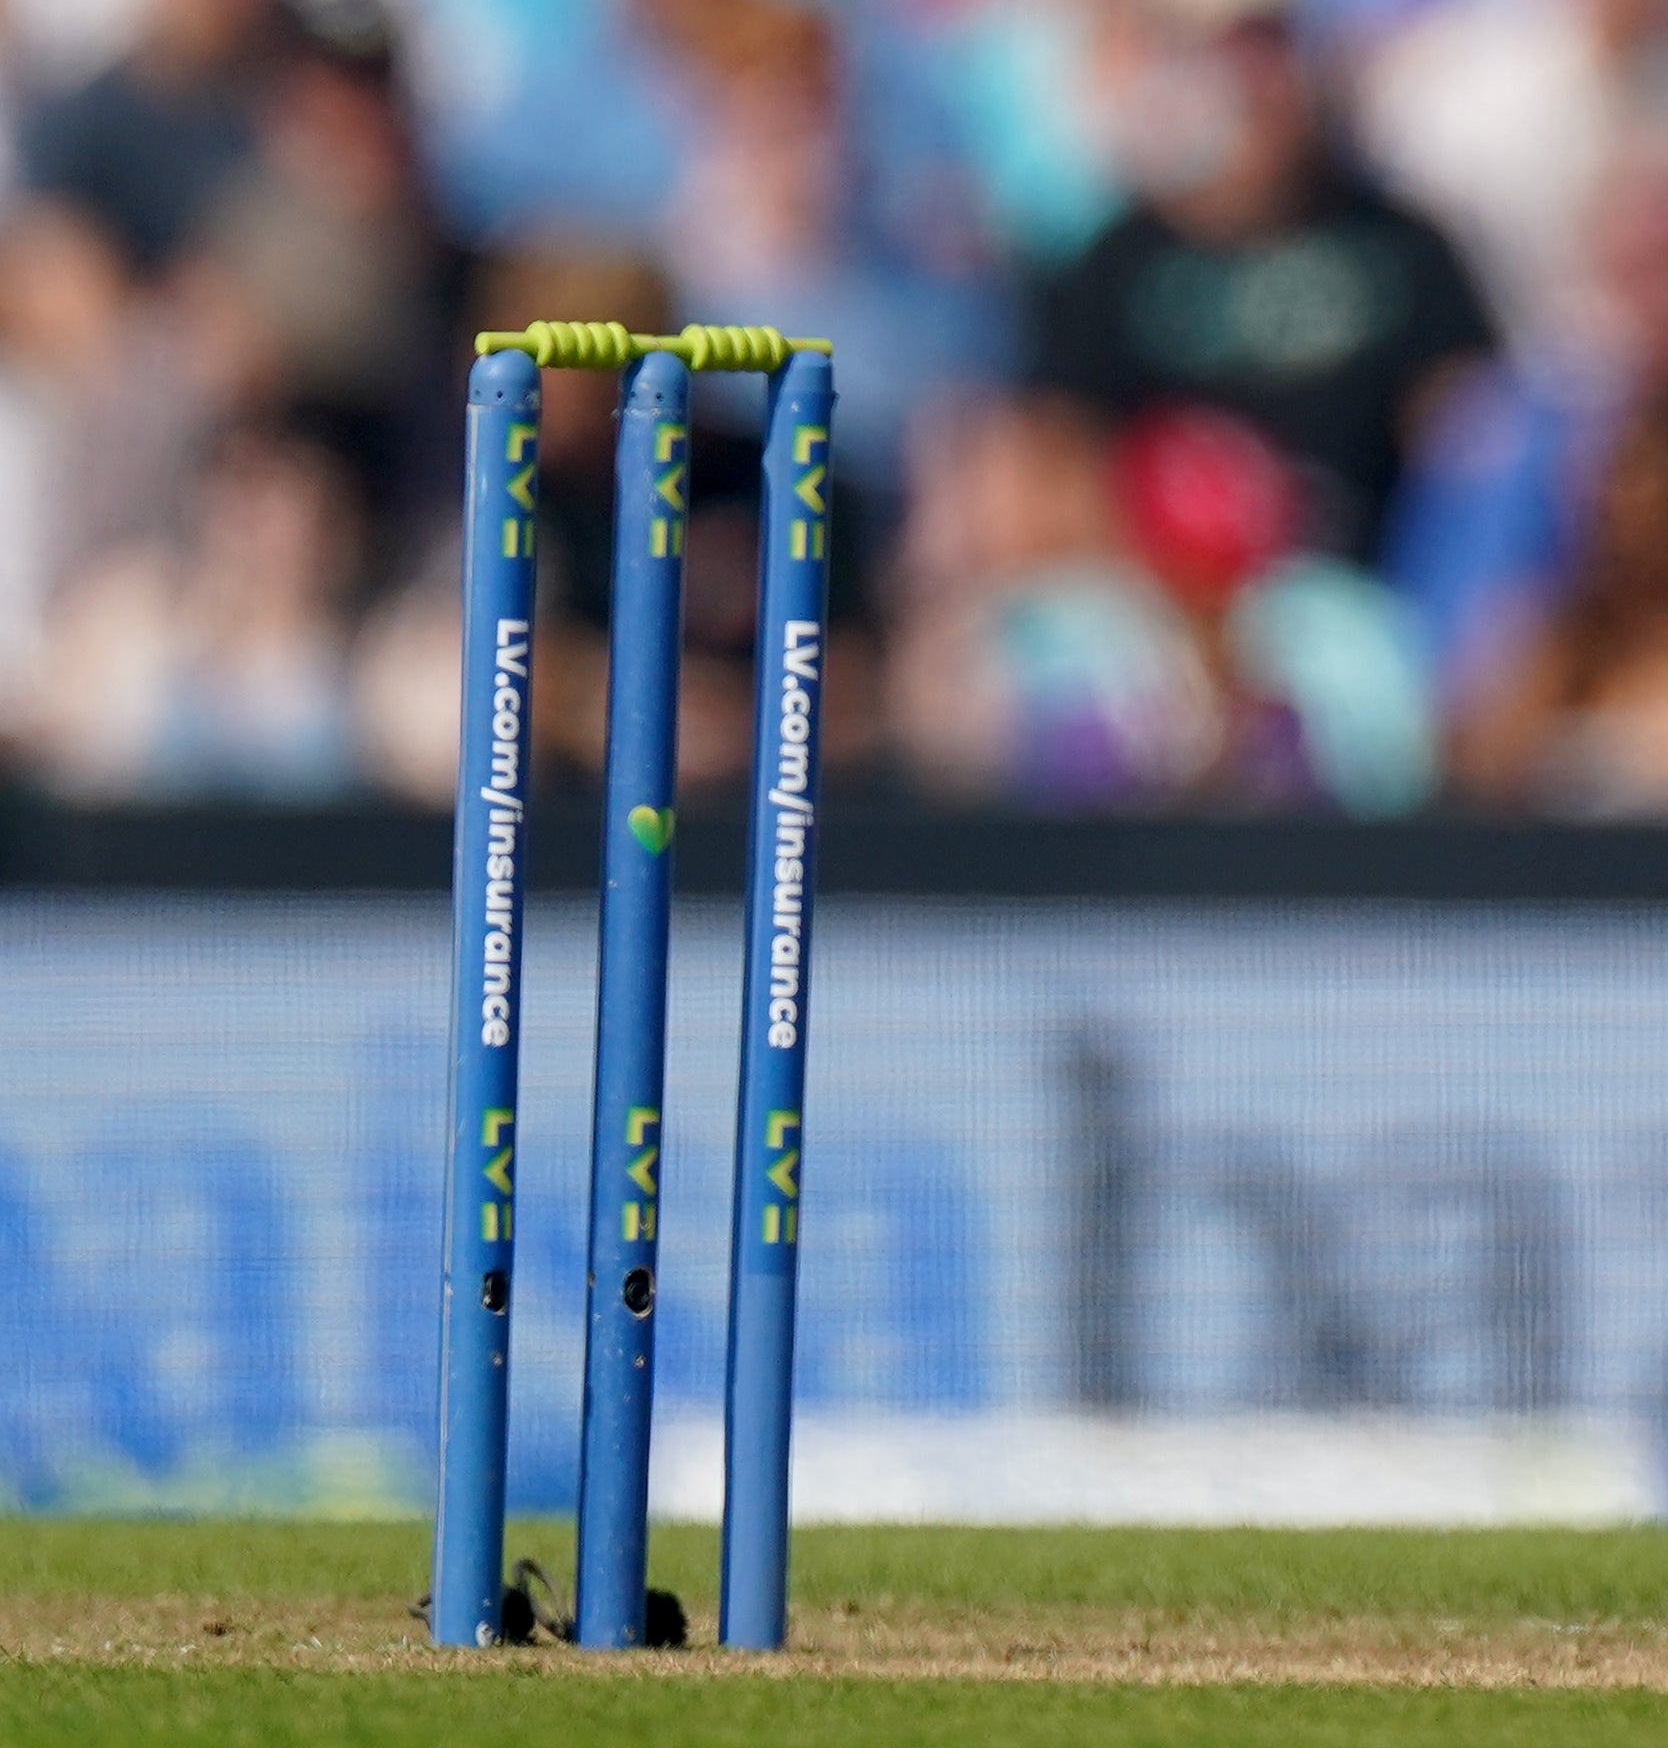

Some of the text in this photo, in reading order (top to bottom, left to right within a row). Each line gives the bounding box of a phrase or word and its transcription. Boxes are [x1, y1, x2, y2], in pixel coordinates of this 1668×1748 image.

[788, 424, 828, 561] LV=
[480, 617, 531, 1049] LV.com/insurance
[768, 619, 820, 1050] LV.com/insurance
[761, 1108, 802, 1245] LV=
